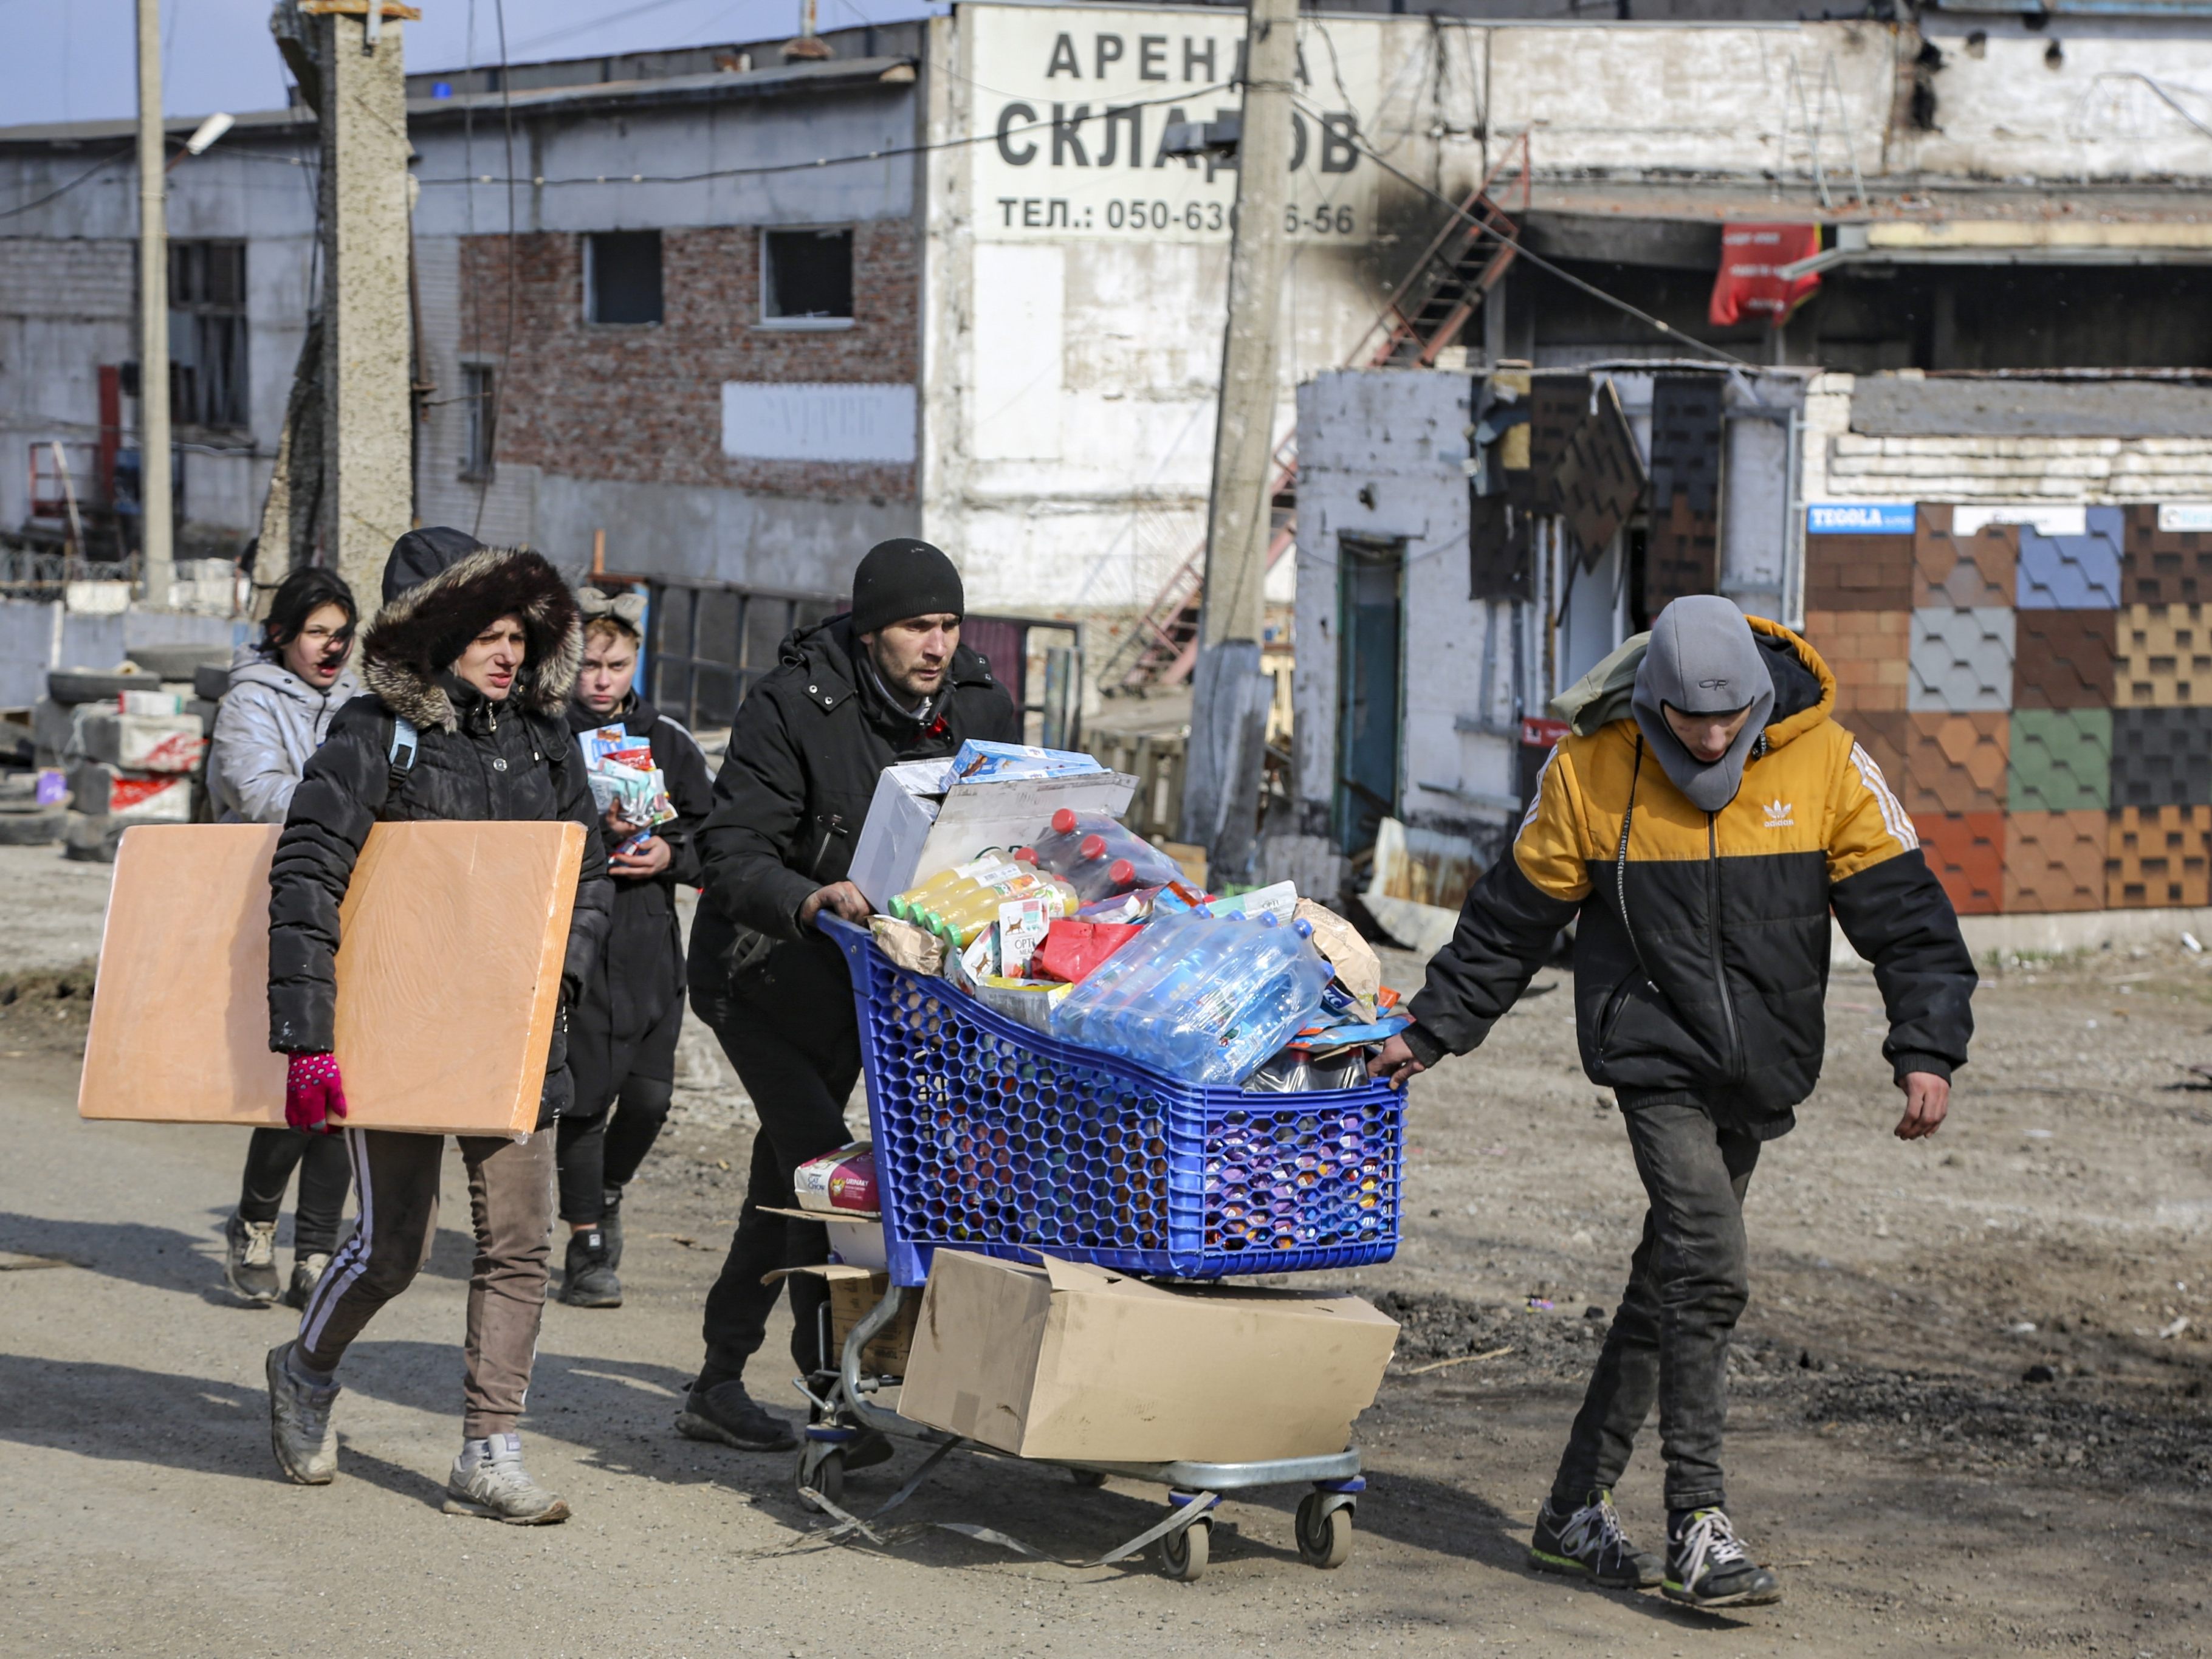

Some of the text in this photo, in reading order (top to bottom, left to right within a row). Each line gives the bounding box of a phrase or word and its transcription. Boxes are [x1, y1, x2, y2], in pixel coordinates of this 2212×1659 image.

[998, 199, 1354, 234] ТЕЛ.: 050-636-56
[1810, 507, 1883, 527] TEGOLA
[1014, 938, 1036, 949] OPTI
